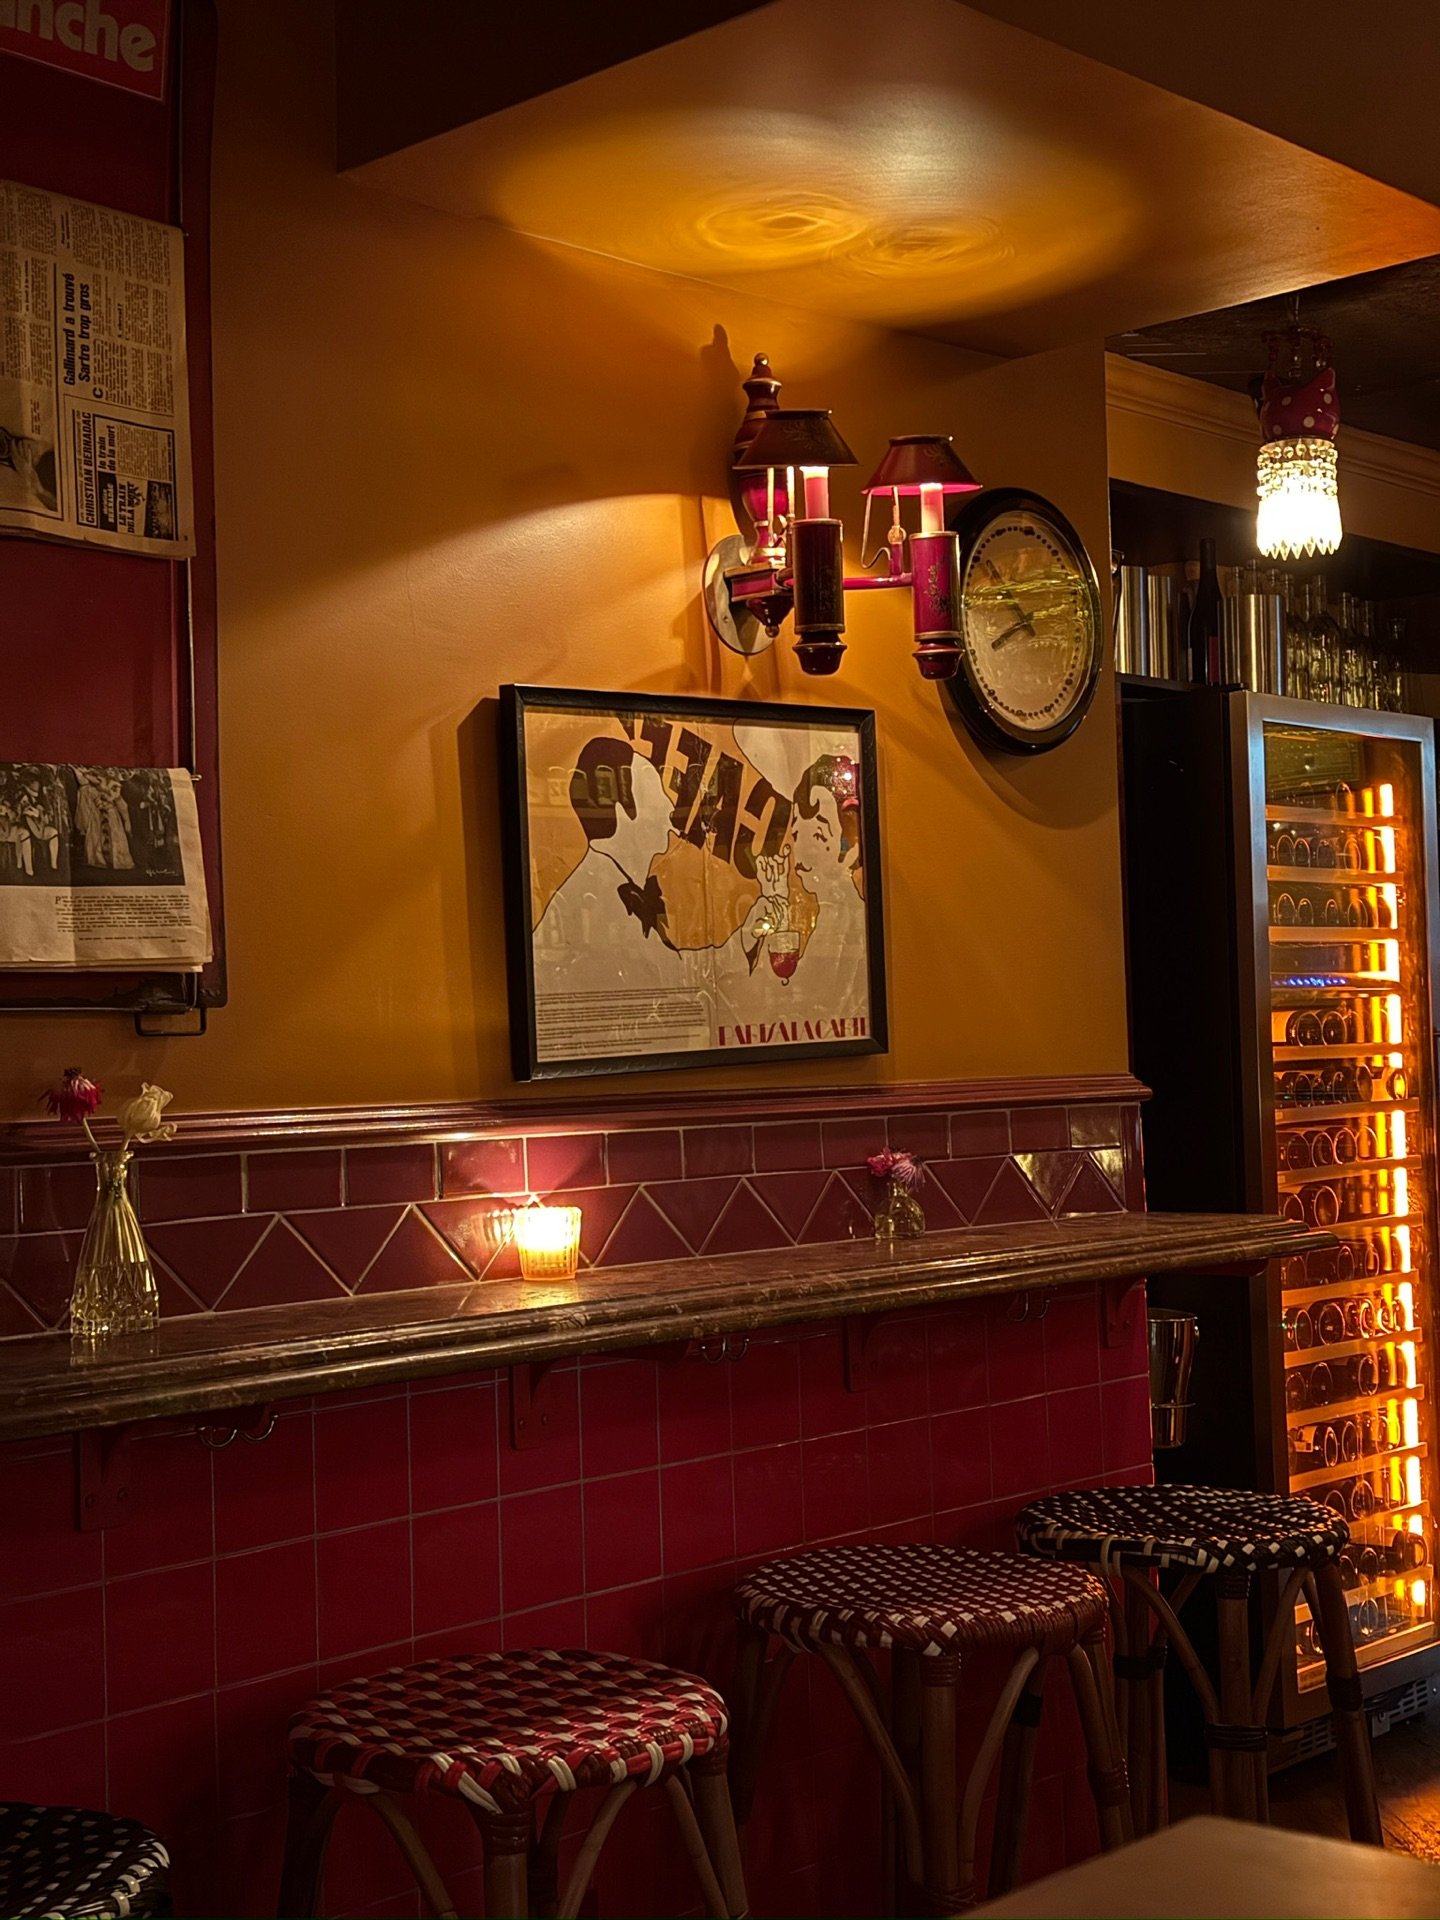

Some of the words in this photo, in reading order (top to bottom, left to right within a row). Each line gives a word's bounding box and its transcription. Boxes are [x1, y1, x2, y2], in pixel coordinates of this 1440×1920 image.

[62, 272, 75, 312] trouvé
[79, 283, 91, 311] gros
[65, 316, 75, 325] a
[79, 315, 91, 340] trop
[63, 328, 76, 386] Gallimard
[78, 344, 90, 382] Sartre
[82, 411, 93, 467] BERNADAC
[97, 436, 107, 459] train
[106, 425, 115, 447] mort
[107, 448, 116, 459] la
[107, 460, 116, 471] de
[84, 469, 95, 524] CHRISTIAN
